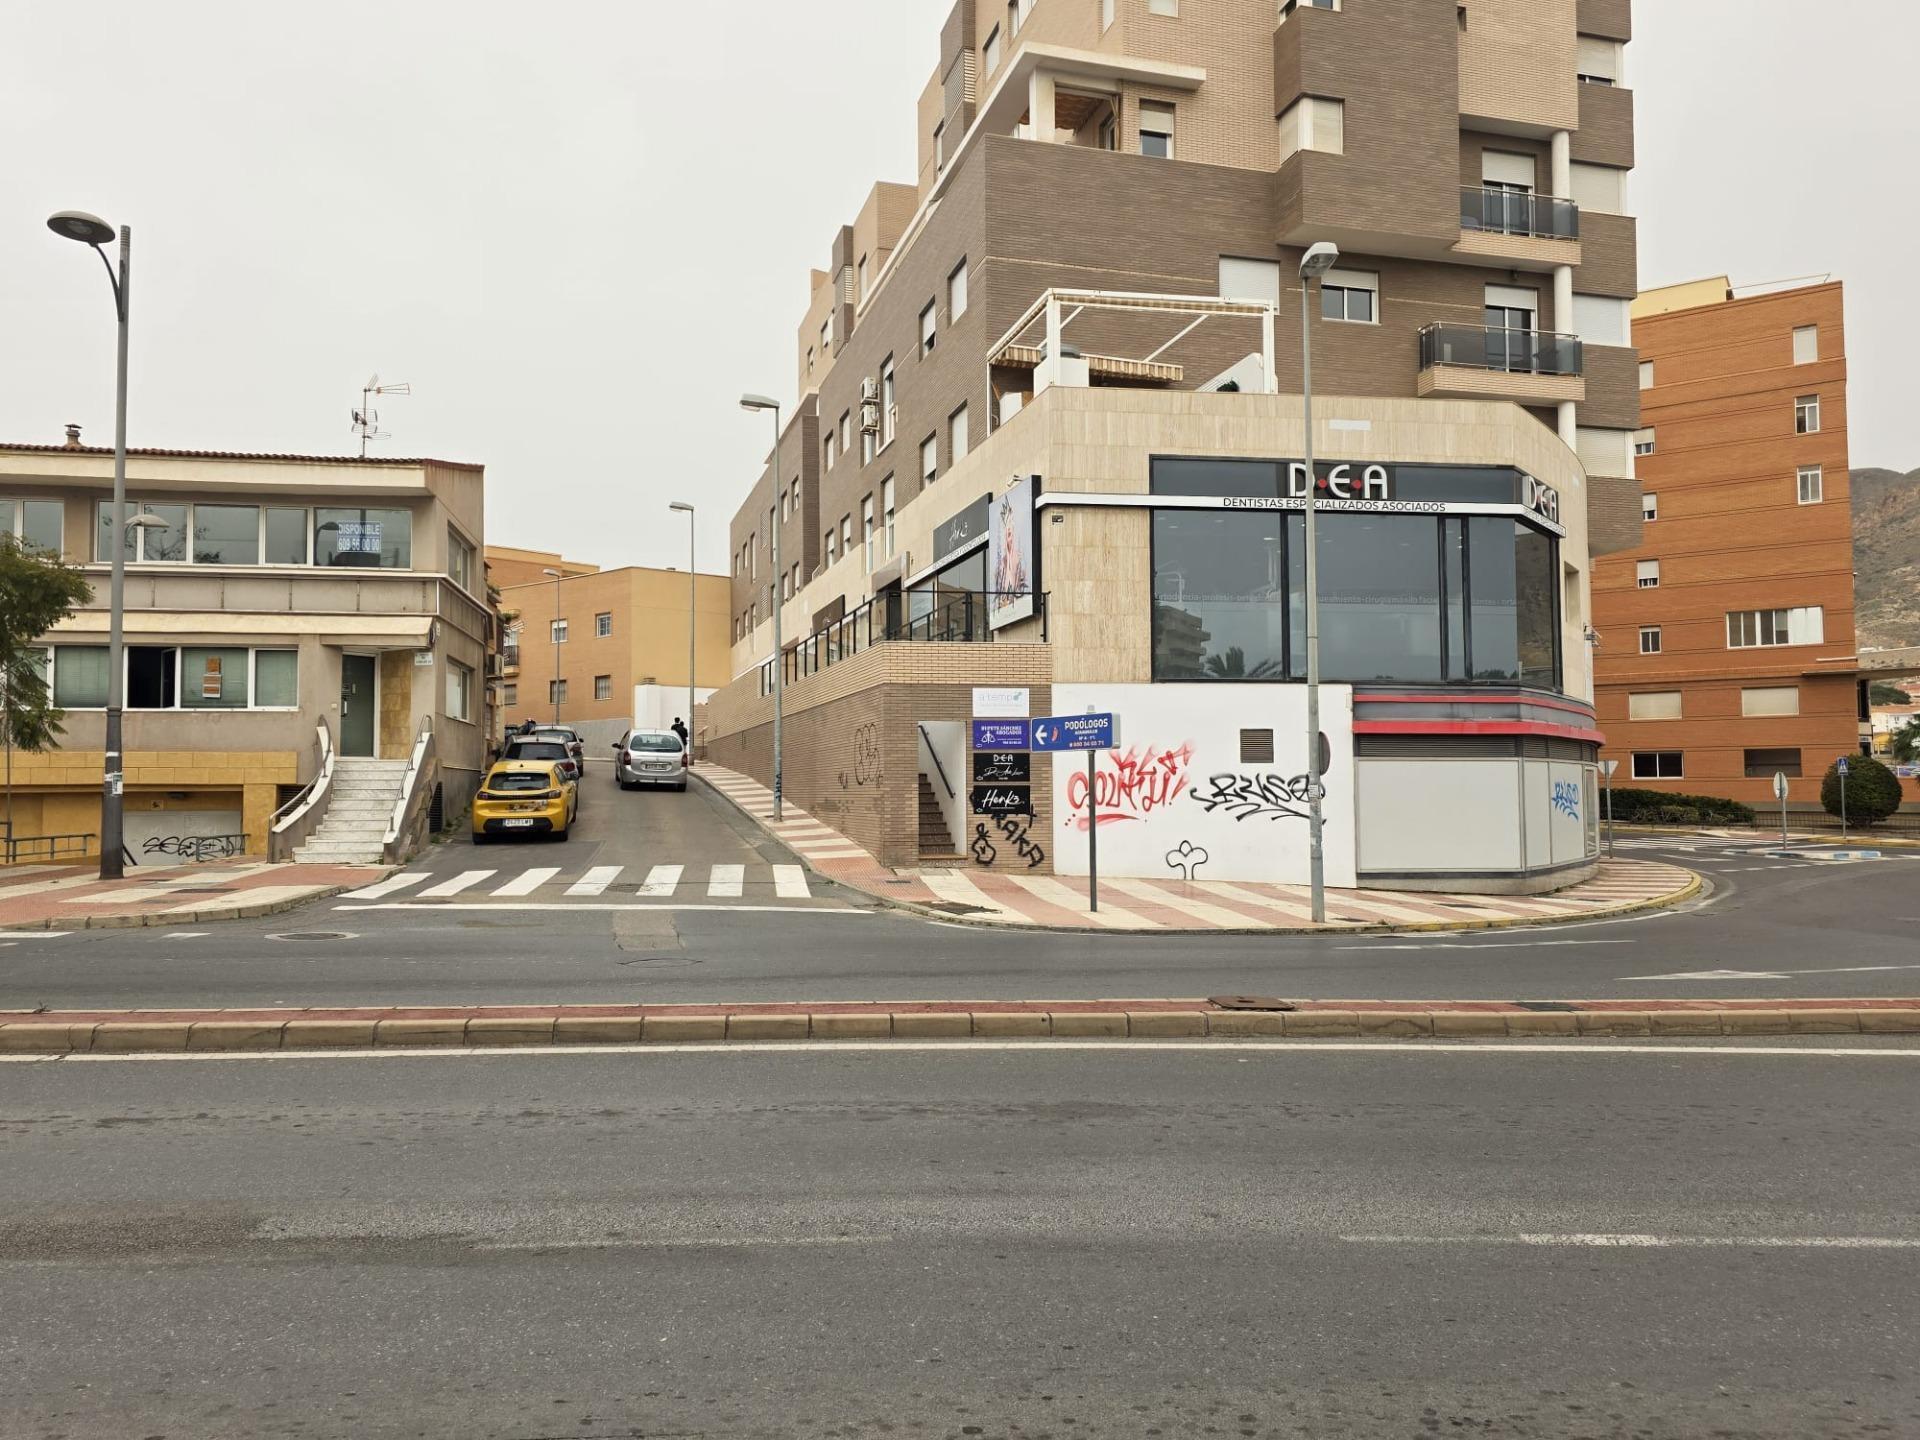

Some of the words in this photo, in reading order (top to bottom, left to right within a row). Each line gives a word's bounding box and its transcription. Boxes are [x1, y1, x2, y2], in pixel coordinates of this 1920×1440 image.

[1223, 497, 1284, 509] DENTISTAS
[1286, 498, 1379, 511] ESPCIALIZADOS
[1381, 502, 1446, 513] ASOCIADOS
[338, 523, 380, 535] DISPONIBLE
[1064, 717, 1109, 731] PODÓLOGOS
